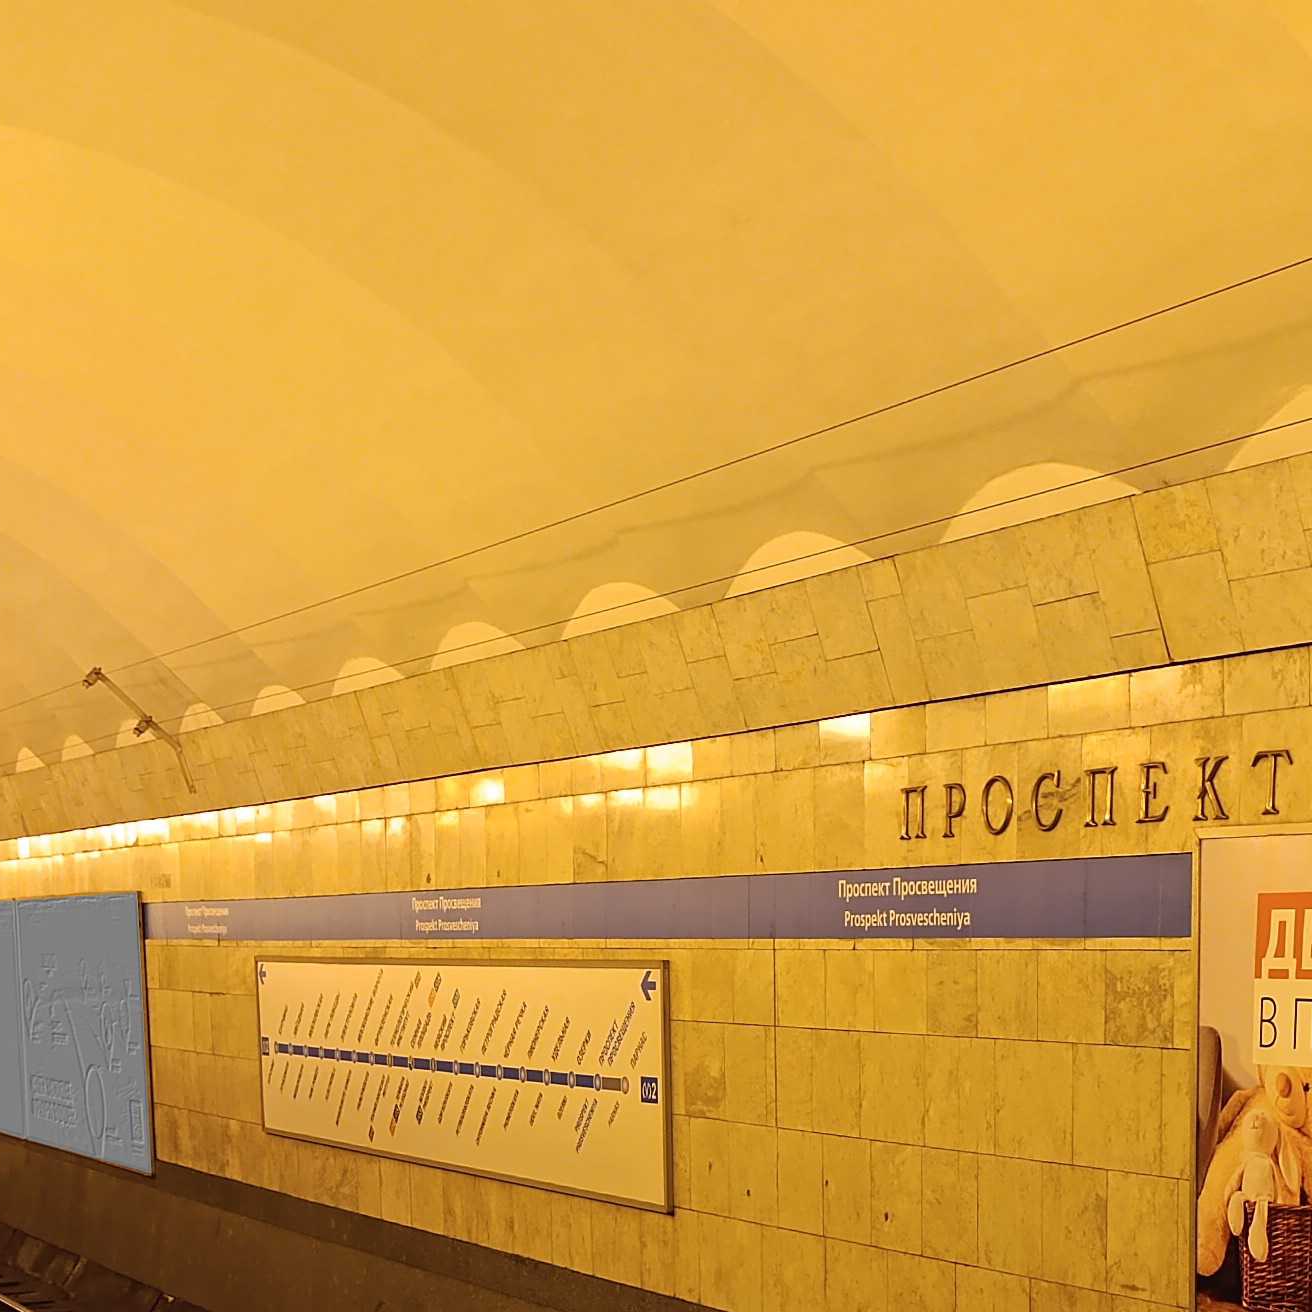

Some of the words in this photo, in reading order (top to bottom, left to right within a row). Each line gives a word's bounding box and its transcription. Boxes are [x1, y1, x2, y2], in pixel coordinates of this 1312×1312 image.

[899, 749, 1294, 840] ПРОСПЕКТ
[838, 879, 890, 902] Проспект
[892, 877, 977, 900] Просвещения
[844, 909, 888, 931] Prospekt
[889, 908, 971, 930] Prosvescheniya
[1259, 997, 1277, 1048] В
